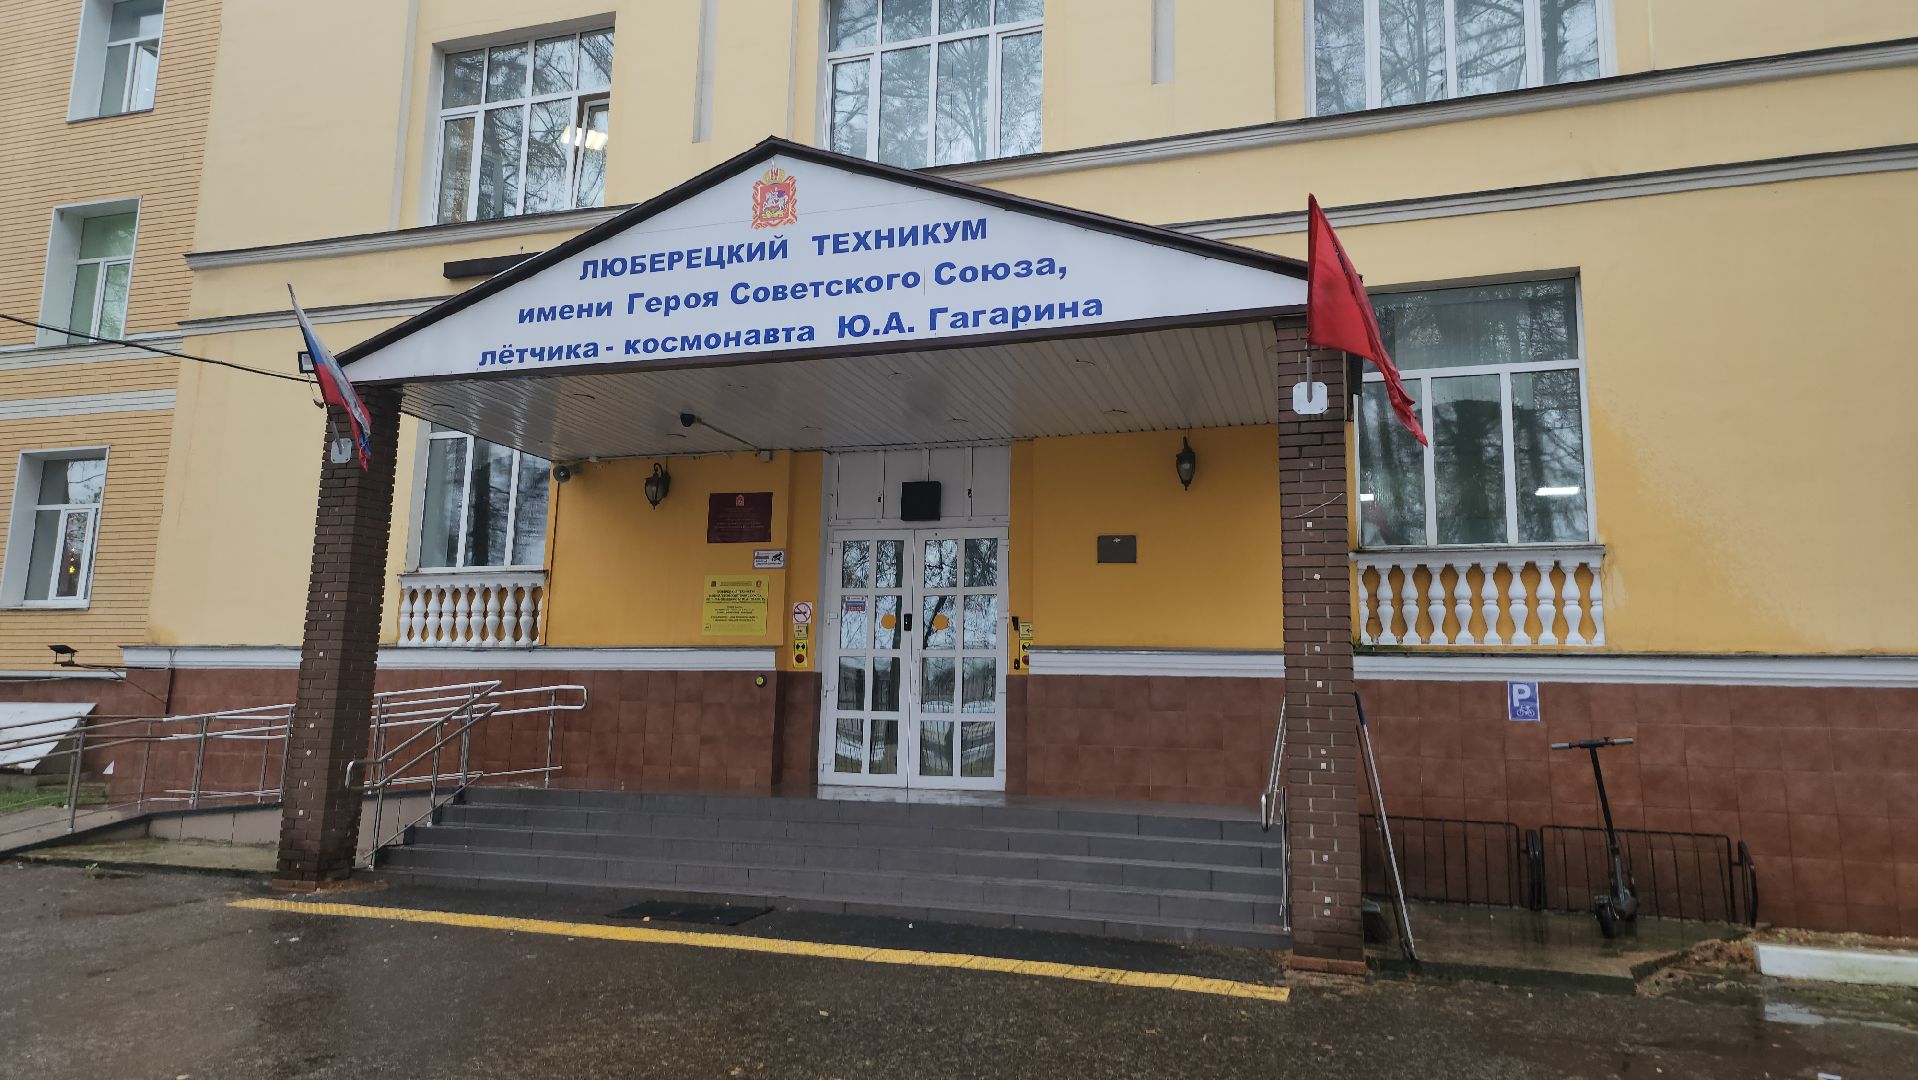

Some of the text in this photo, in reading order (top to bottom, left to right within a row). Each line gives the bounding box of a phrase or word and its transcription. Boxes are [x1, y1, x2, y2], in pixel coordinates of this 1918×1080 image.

[579, 216, 989, 281] ЛЮБЕРЕЦКИЙ ТЕХНИКУМ
[516, 256, 1069, 325] имени Героя Советского Союза,
[624, 324, 817, 356] космонавта
[836, 309, 917, 341] Ю.А.
[928, 296, 1104, 333] Гагарина
[1512, 683, 1531, 708] P
